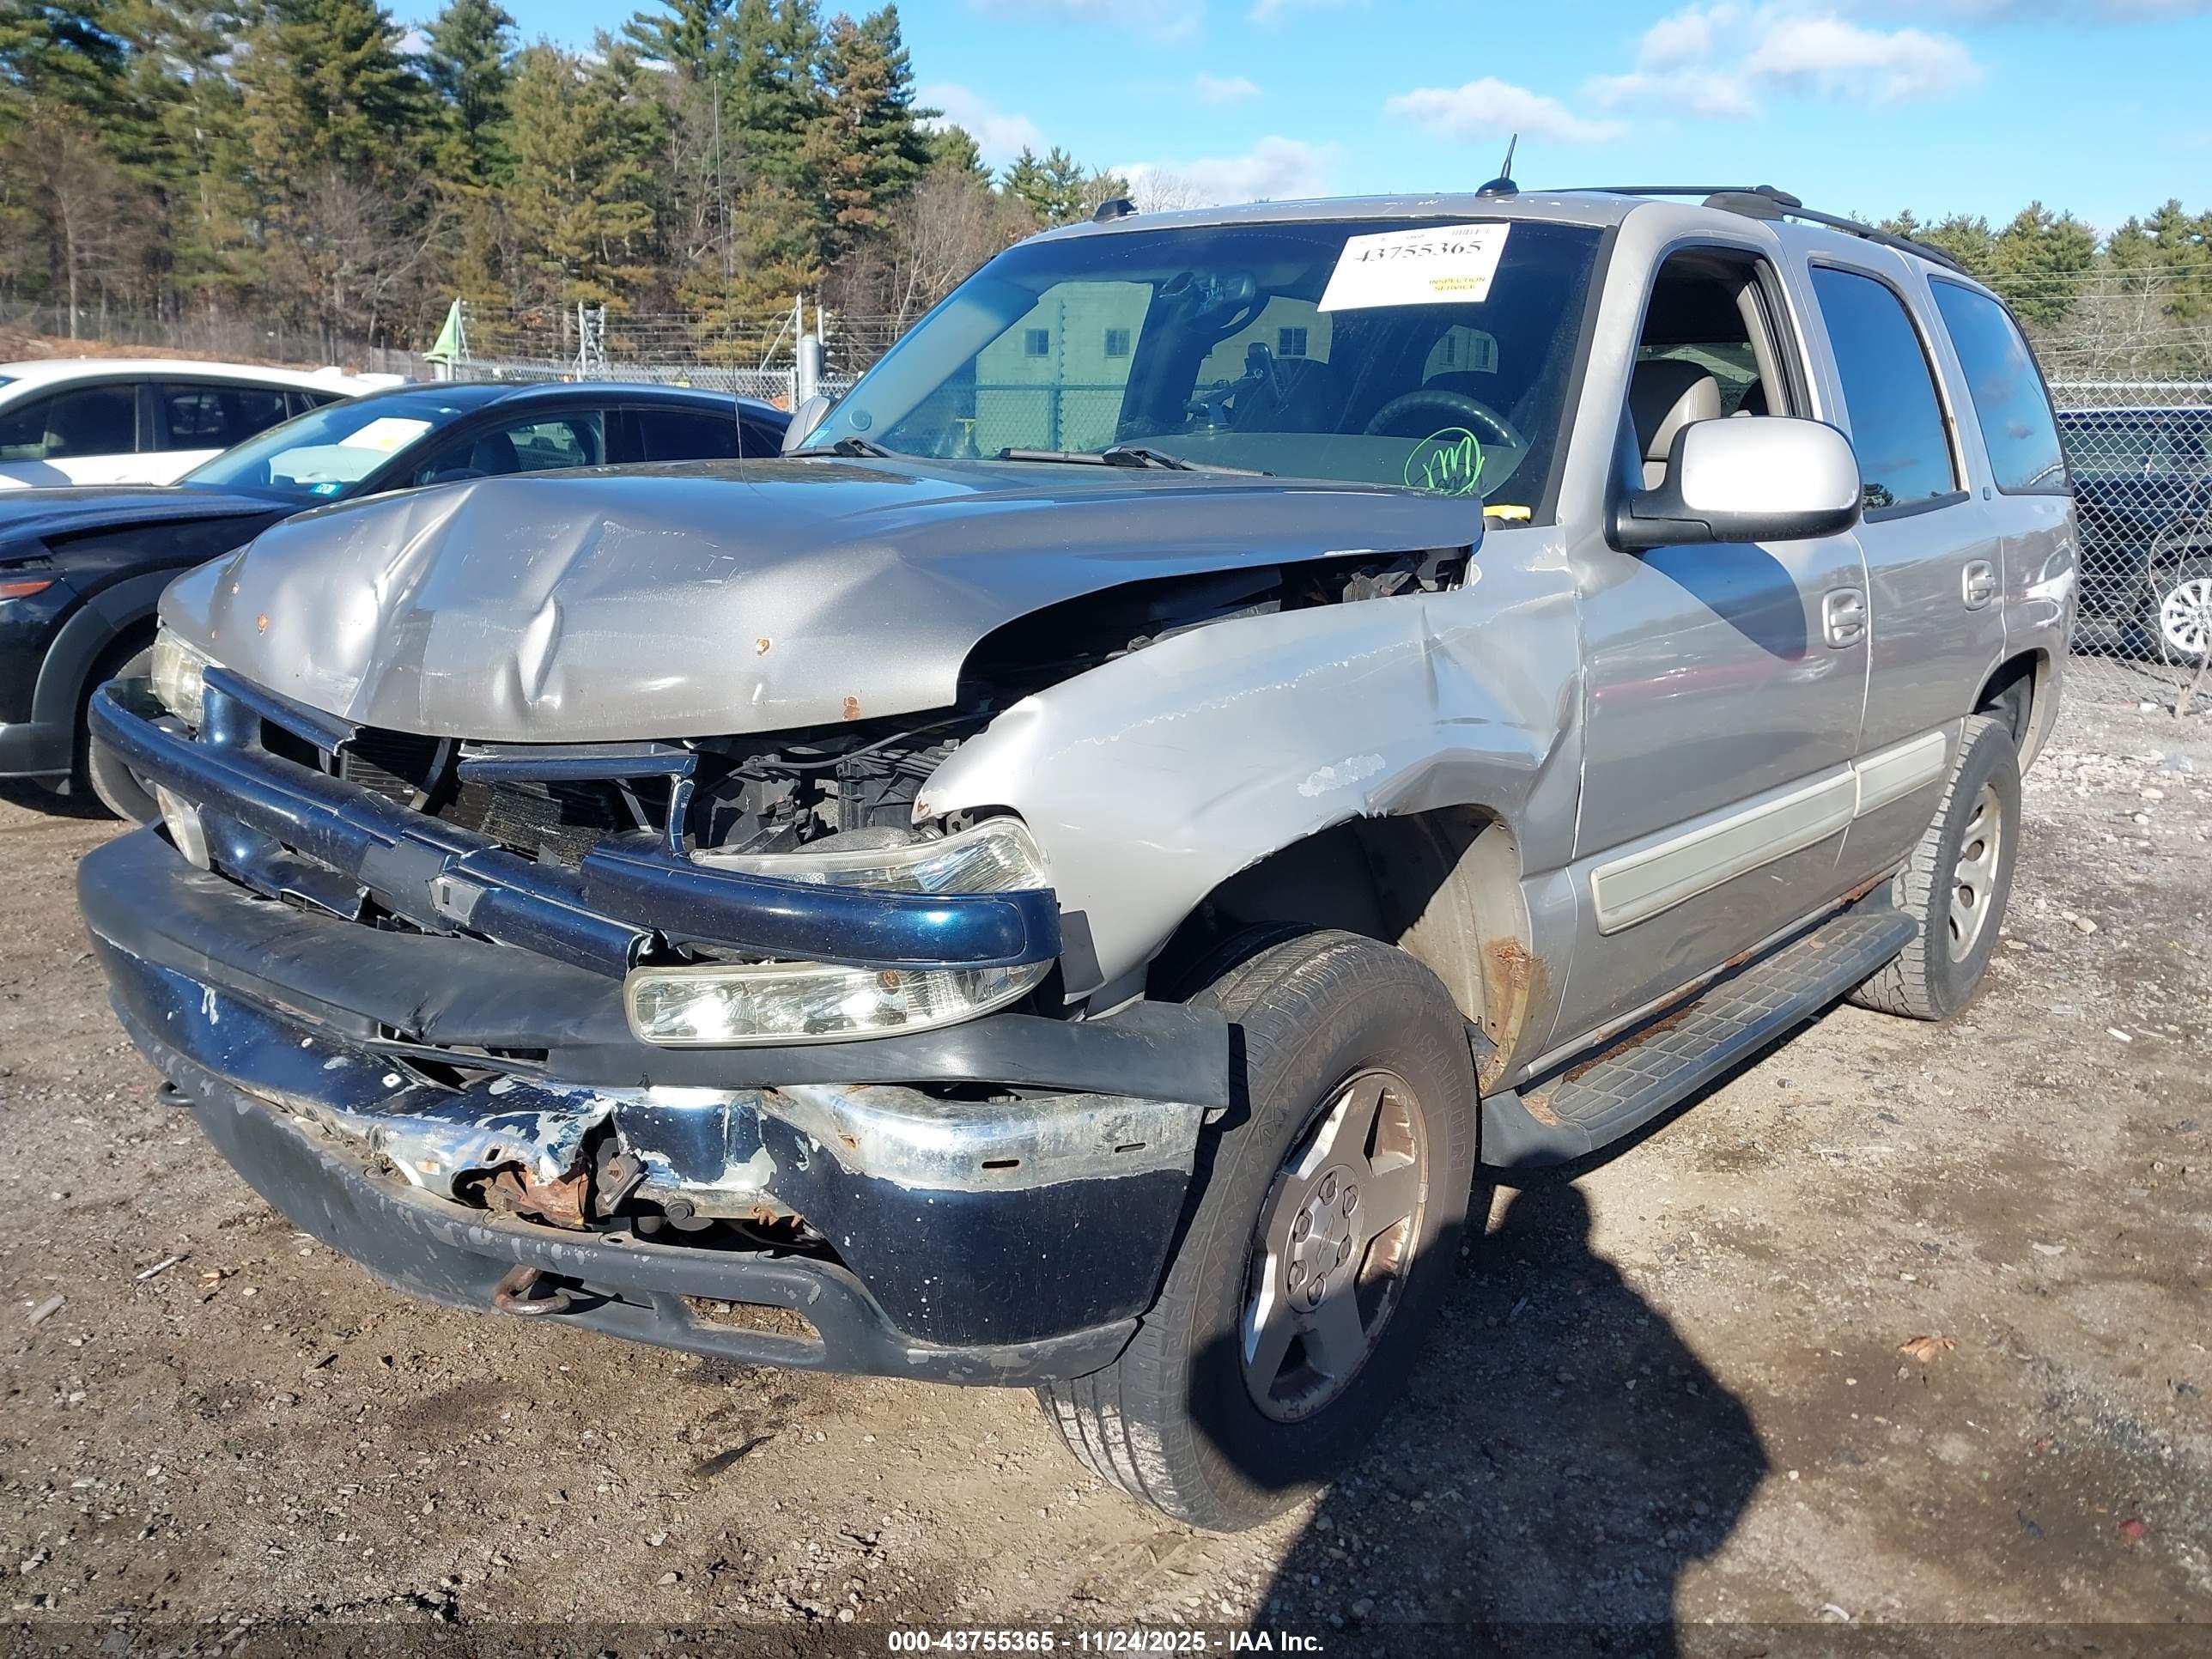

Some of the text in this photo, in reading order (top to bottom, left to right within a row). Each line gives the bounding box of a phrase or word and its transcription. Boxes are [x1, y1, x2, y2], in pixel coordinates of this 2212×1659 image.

[1353, 240, 1484, 262] 43755365
[1429, 276, 1486, 285] INSPECTION
[1435, 283, 1475, 292] SERVICE
